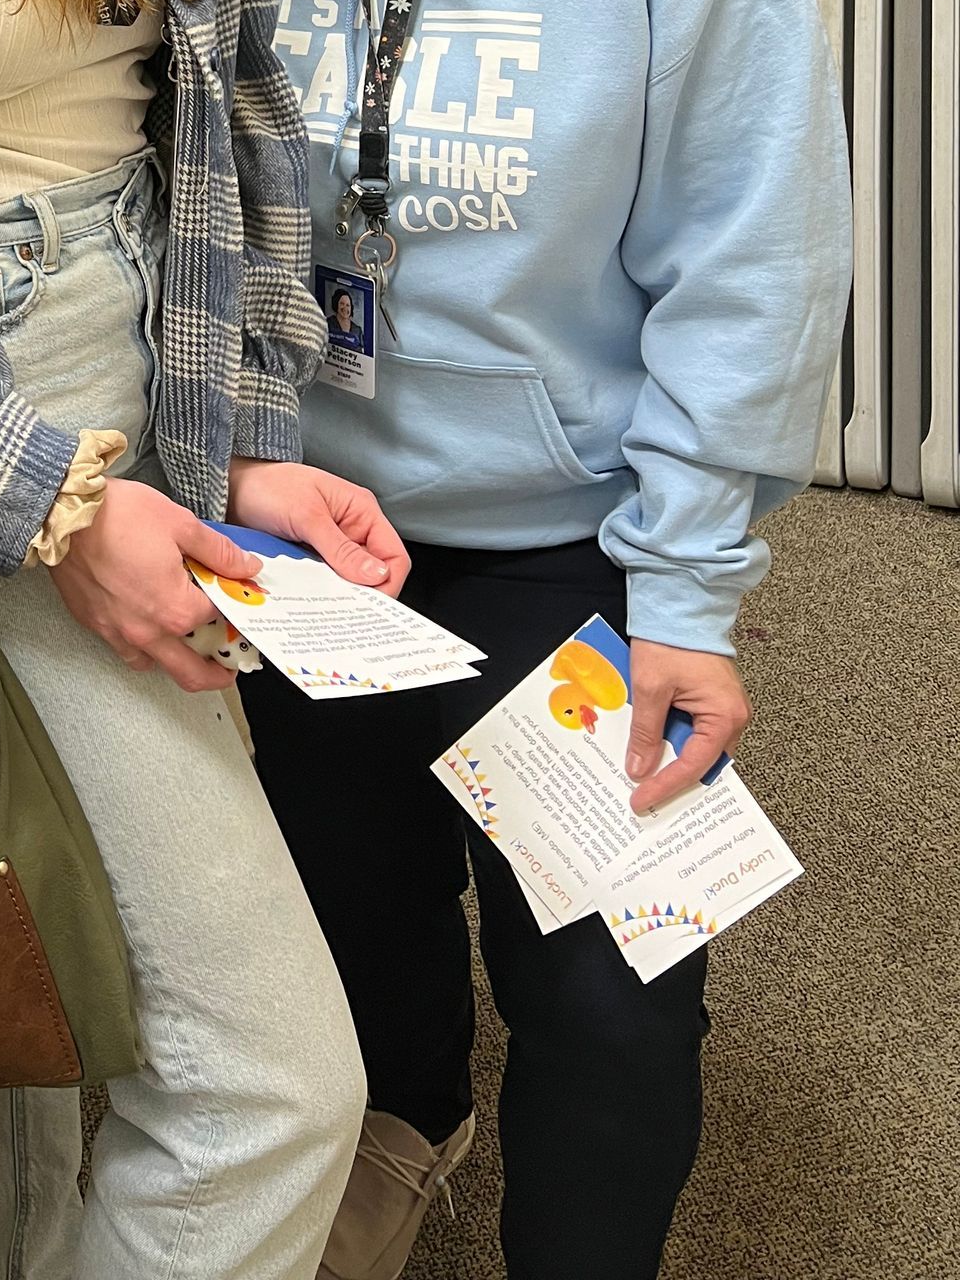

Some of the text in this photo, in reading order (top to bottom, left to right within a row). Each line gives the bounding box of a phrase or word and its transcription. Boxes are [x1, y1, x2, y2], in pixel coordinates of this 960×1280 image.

[395, 133, 530, 196] THING
[398, 191, 519, 233] COSA
[327, 351, 362, 369] Peterson
[331, 345, 357, 360] Stacey
[388, 668, 426, 681] Duck!
[501, 706, 508, 715] is
[508, 713, 520, 728] this
[521, 714, 539, 730] your
[519, 727, 536, 745] done
[535, 729, 559, 755] without
[504, 741, 512, 750] in
[583, 734, 618, 773] Farnsworth
[511, 749, 526, 766] help
[535, 745, 552, 764] have
[559, 755, 574, 772] time
[567, 749, 602, 785] Awesome!
[524, 766, 540, 784] Your
[551, 762, 577, 790] couldn't
[571, 771, 581, 779] of
[576, 790, 588, 806] We
[580, 779, 605, 806] amount
[601, 785, 613, 798] are
[704, 785, 730, 803] testing
[490, 744, 603, 872] Thank you for all of your help with our
[526, 750, 620, 856] testing and scoring was greatly
[612, 798, 626, 815] You
[689, 801, 704, 815] and
[711, 796, 736, 813] Middle
[565, 812, 582, 831] Year
[604, 806, 622, 825] short
[702, 811, 710, 822] of
[718, 807, 743, 823] Thank
[621, 824, 636, 841] that
[684, 818, 703, 831] Year
[704, 819, 718, 832] you
[580, 830, 590, 838] of
[682, 837, 692, 848] all
[693, 830, 704, 840] for
[531, 820, 588, 887] Inez Aguado (ME)
[589, 838, 612, 864] Middle
[657, 847, 674, 863] your
[674, 843, 682, 854] of
[677, 826, 755, 878] Kathy Anderson (ME)
[511, 839, 572, 908] Lucky Duck!
[639, 859, 657, 872] help
[623, 870, 640, 882] with
[703, 849, 774, 900] Lucky Duck!
[610, 879, 623, 890] our
